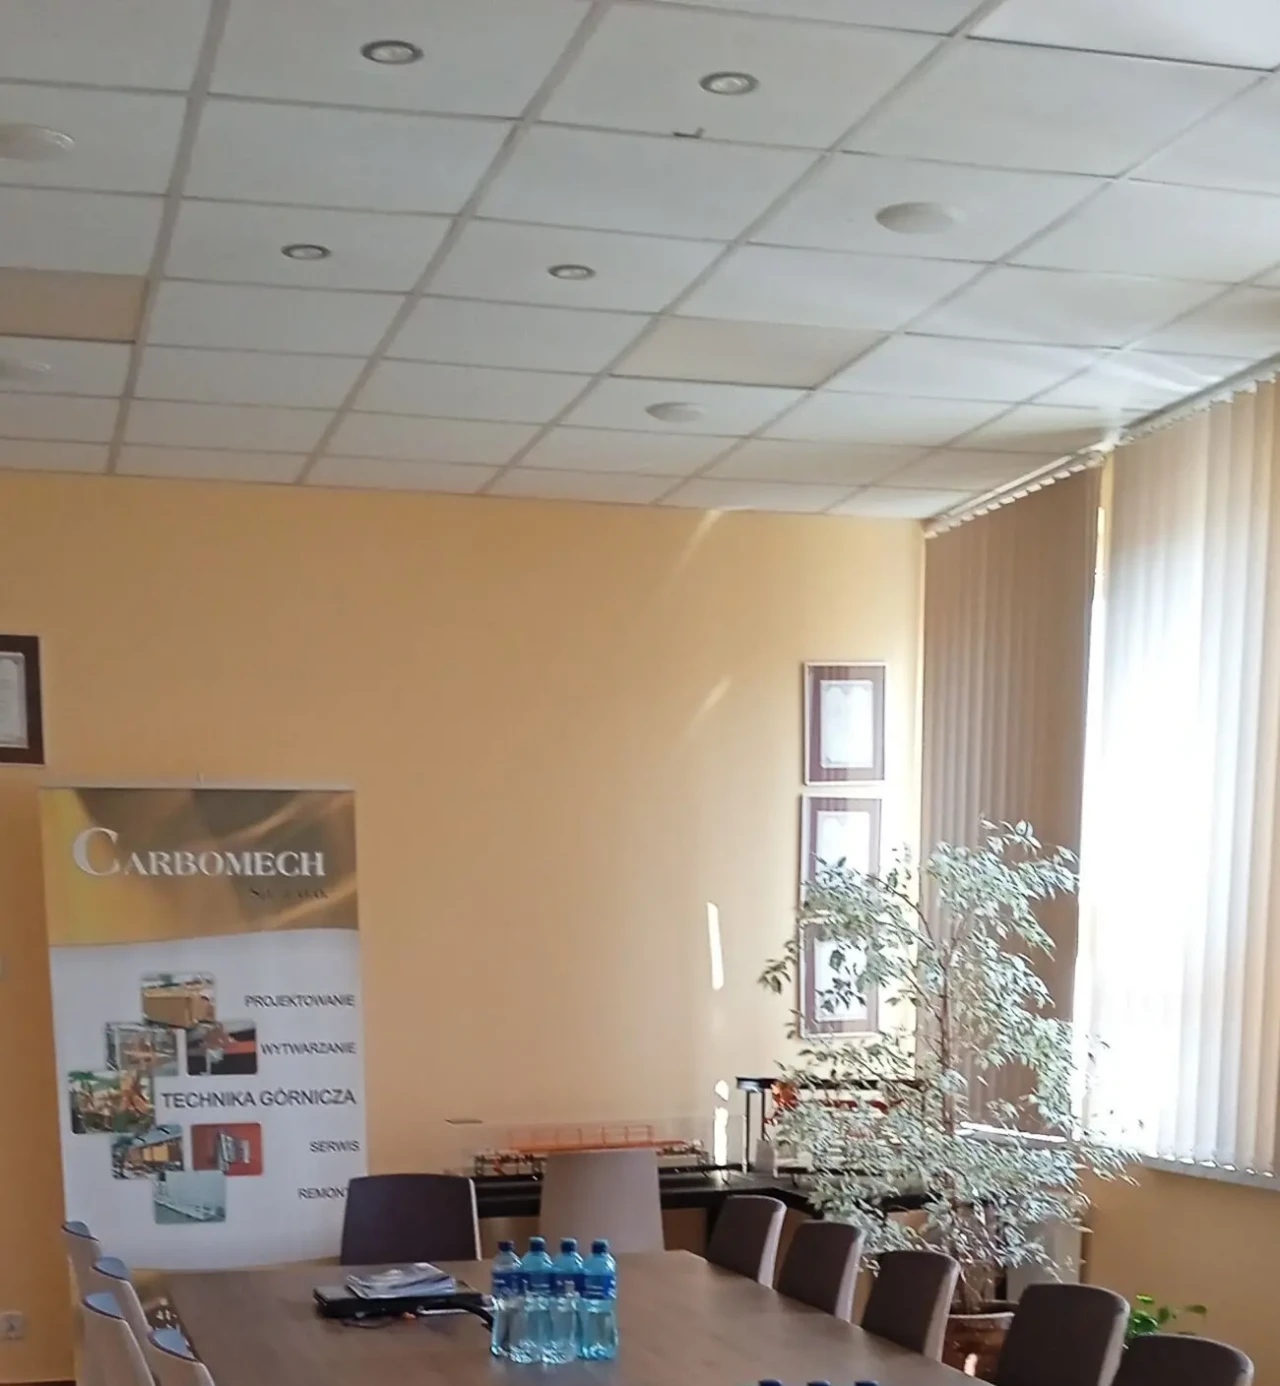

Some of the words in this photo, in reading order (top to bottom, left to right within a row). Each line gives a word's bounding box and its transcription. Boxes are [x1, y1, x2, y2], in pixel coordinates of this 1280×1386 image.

[73, 827, 325, 876] CARBOMECH
[244, 994, 355, 1008] PROJEKTOWANIE
[260, 1042, 356, 1055] WYTWARZANIE
[161, 1091, 256, 1108] TECHNIKA
[258, 1087, 356, 1107] GÓRNICZA
[309, 1140, 360, 1152] SERWIS
